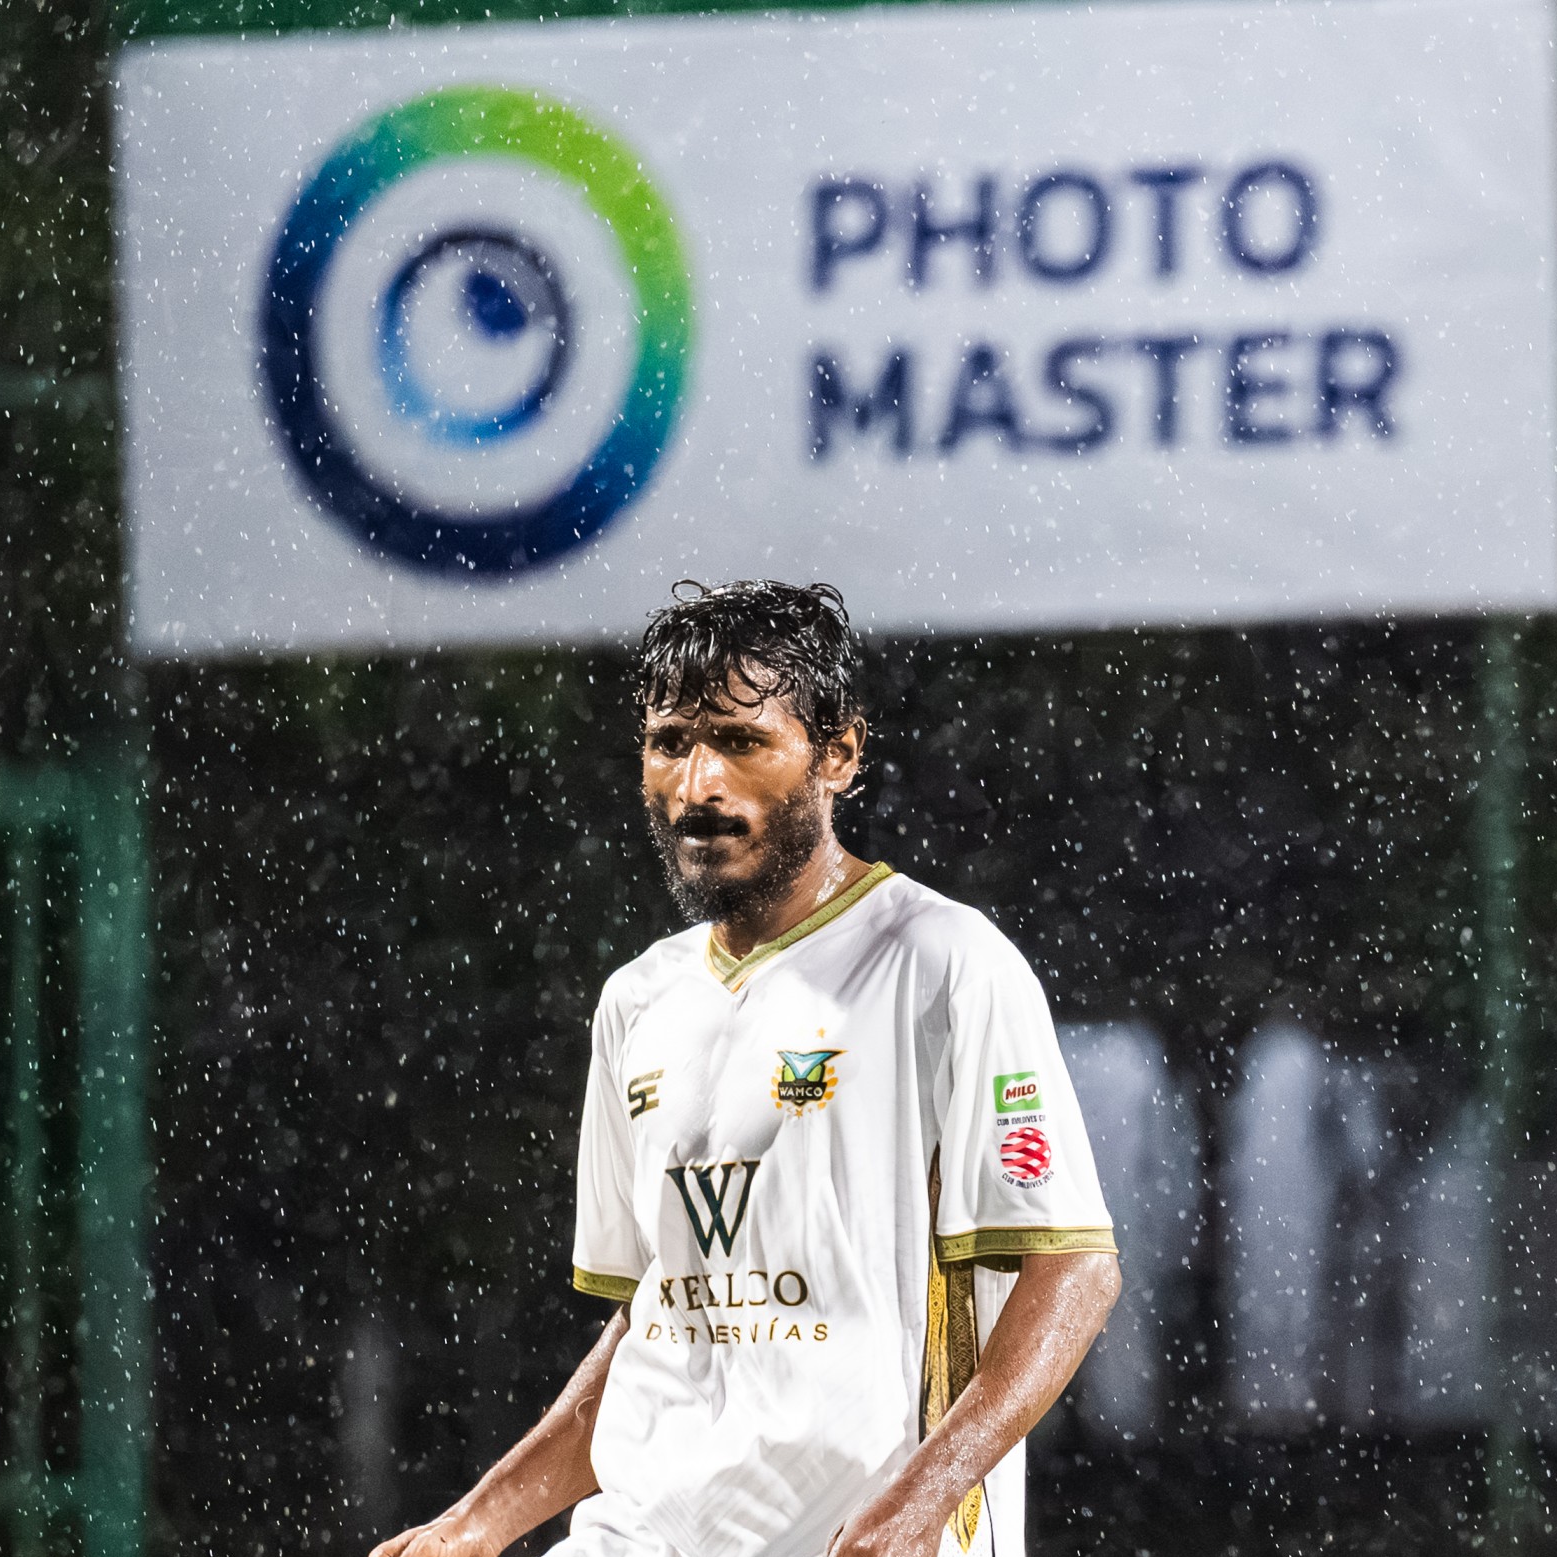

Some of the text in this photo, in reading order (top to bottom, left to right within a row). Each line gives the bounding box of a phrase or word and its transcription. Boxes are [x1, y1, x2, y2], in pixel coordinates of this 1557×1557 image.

[805, 162, 1323, 294] PHOTO
[803, 326, 1404, 464] MASTER
[778, 1086, 824, 1098] WAMCO
[1005, 1083, 1037, 1101] MILO
[665, 1160, 761, 1259] W
